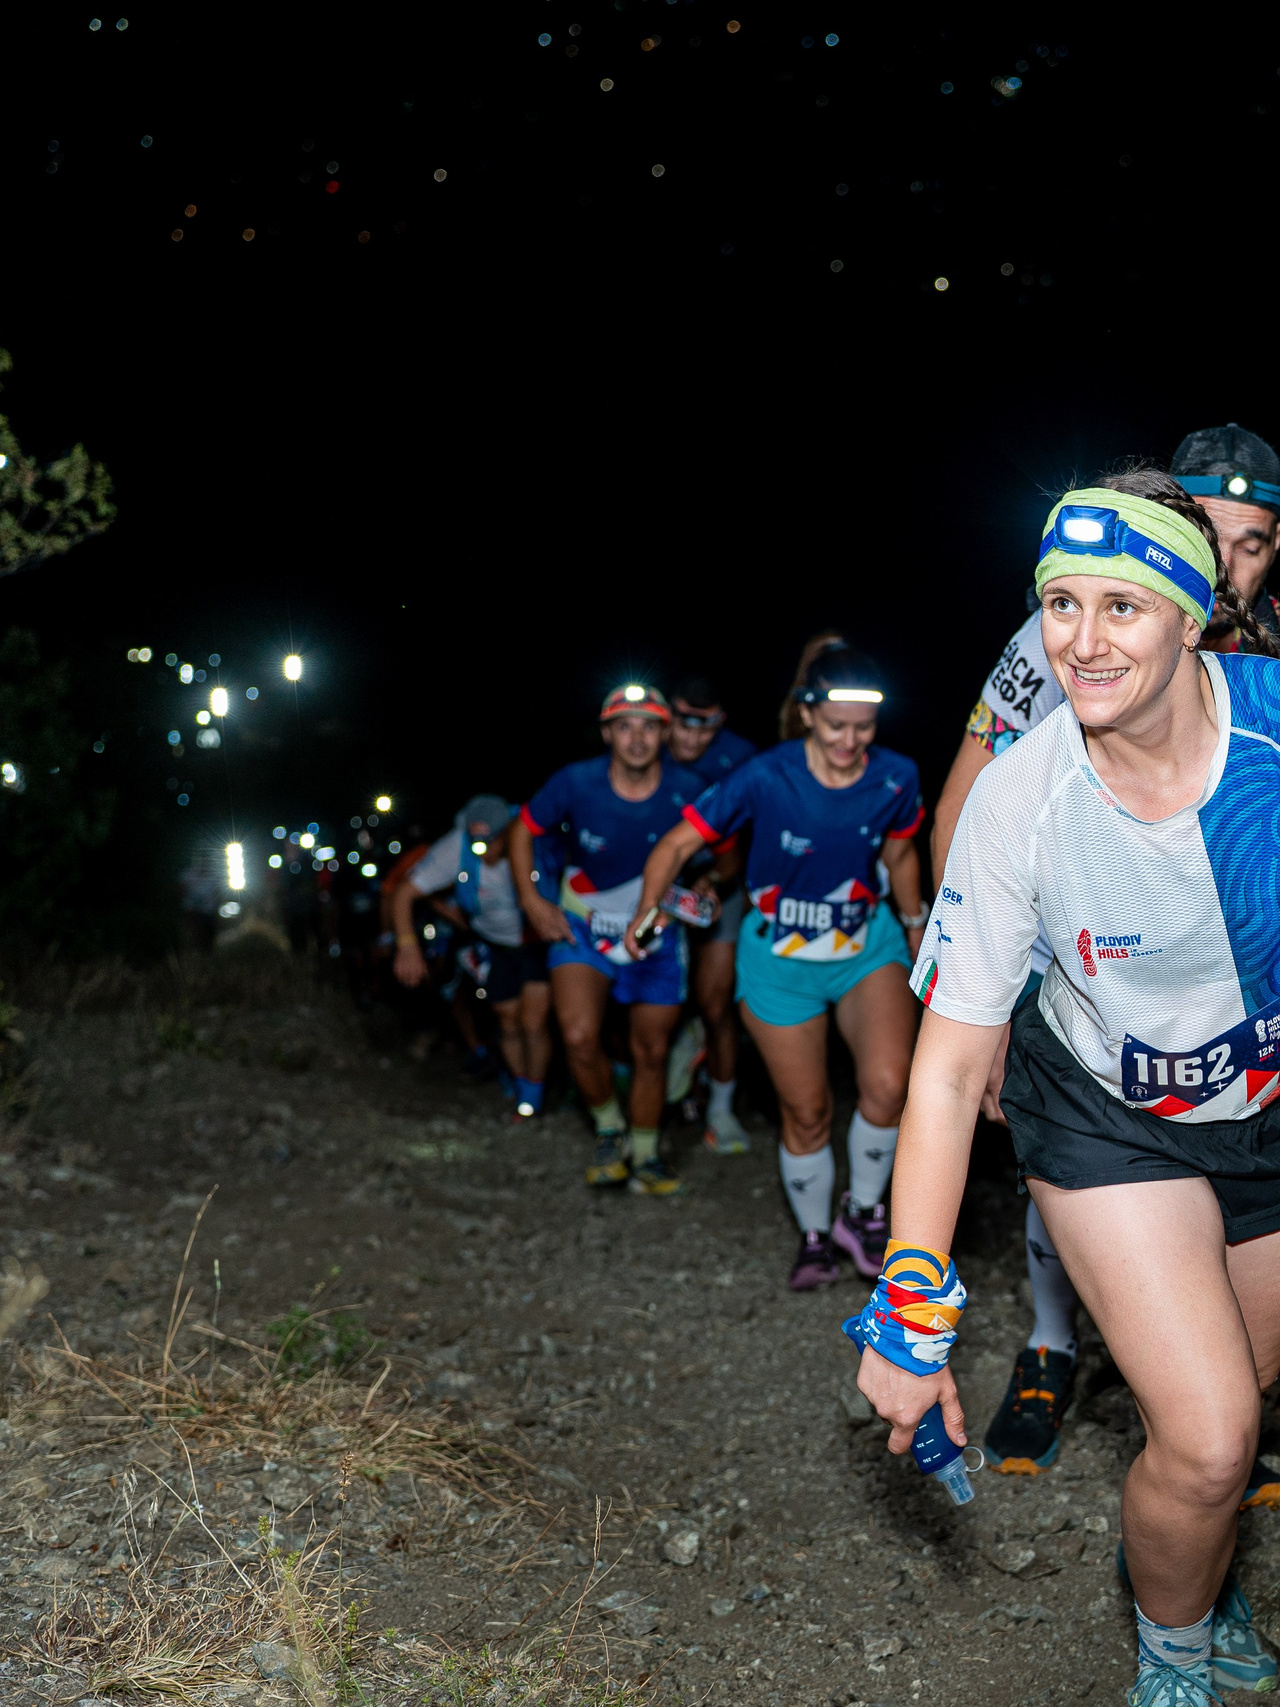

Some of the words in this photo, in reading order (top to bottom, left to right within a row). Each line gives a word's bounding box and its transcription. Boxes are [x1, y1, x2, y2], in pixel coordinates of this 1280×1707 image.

[1146, 546, 1172, 570] PETZL
[942, 885, 963, 905] GER
[780, 897, 833, 931] 0118
[1095, 934, 1141, 947] PLOVDIV
[1098, 949, 1129, 959] HILLS
[1258, 1044, 1275, 1058] 12K
[1133, 1043, 1234, 1087] 1162
